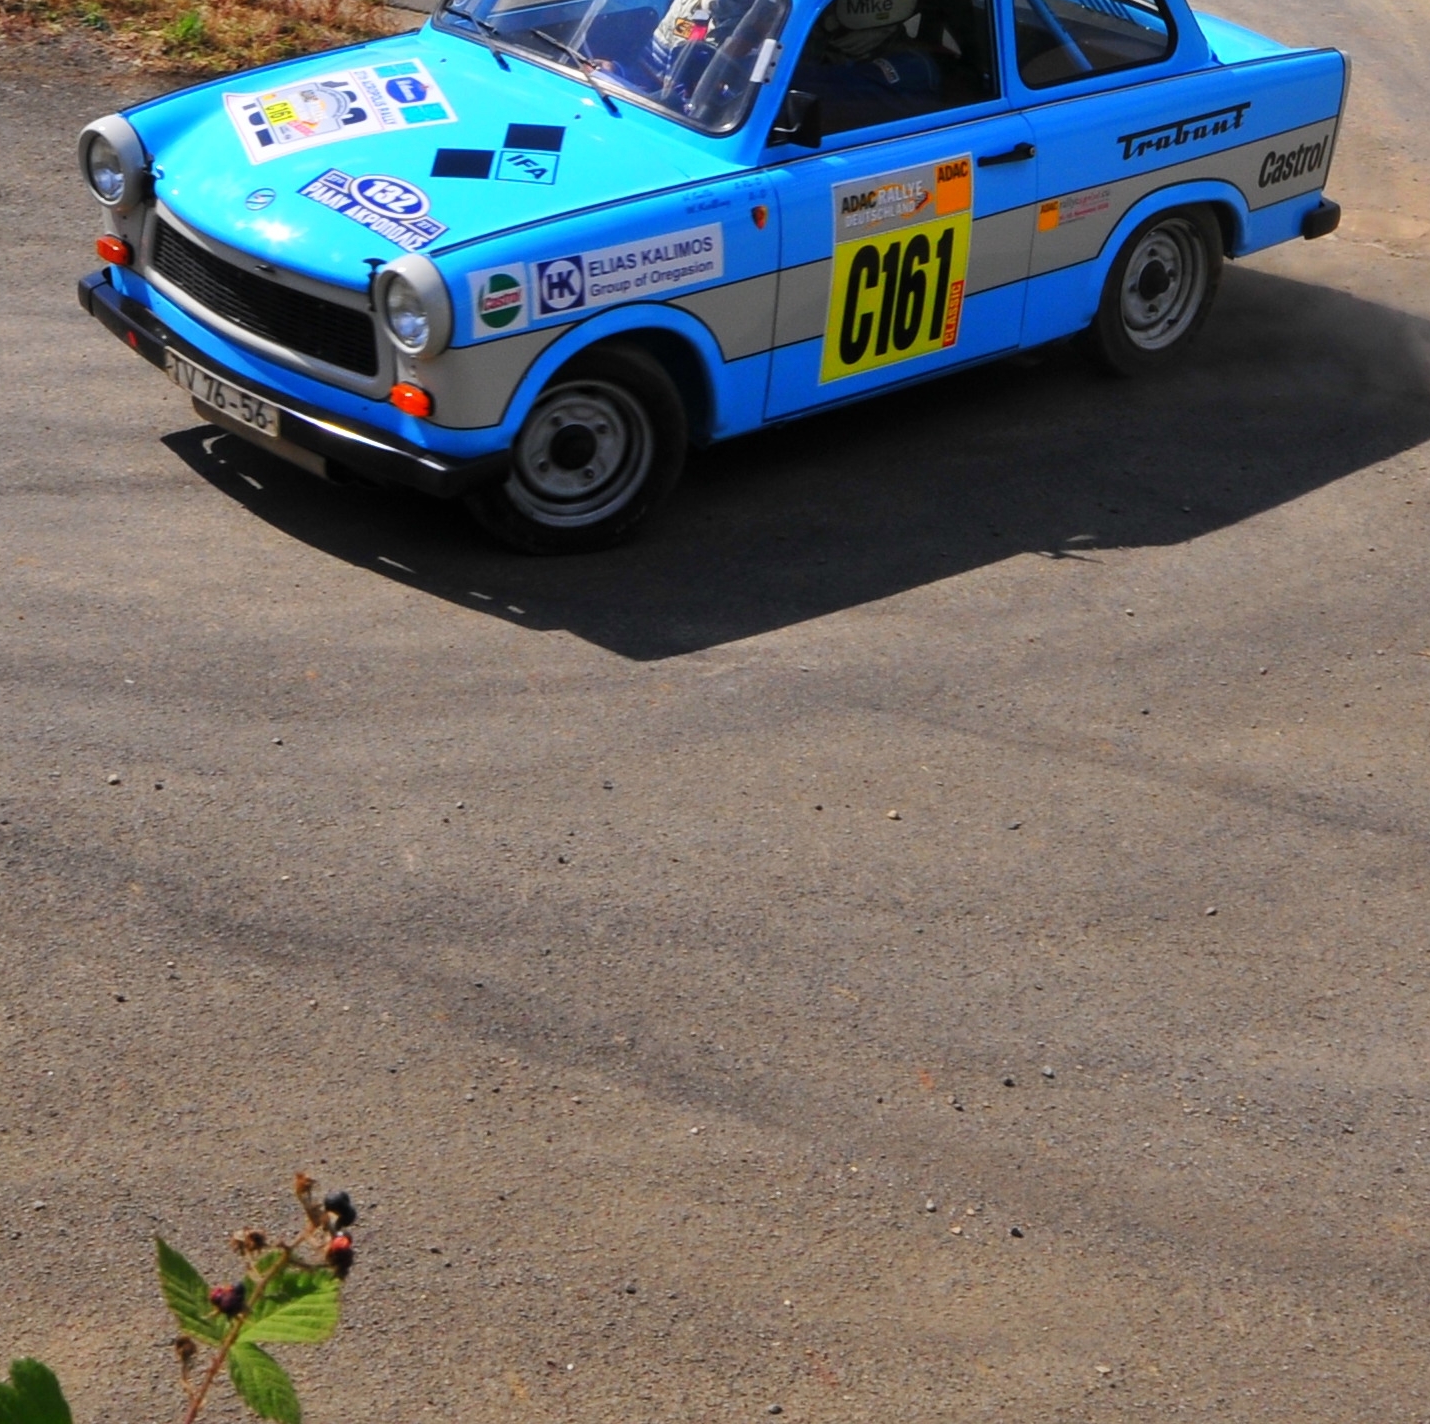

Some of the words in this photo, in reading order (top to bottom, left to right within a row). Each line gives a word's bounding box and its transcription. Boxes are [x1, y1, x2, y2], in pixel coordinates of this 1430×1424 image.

[1117, 101, 1252, 161] Trabant
[506, 154, 548, 180] IFA
[937, 161, 968, 184] ADAC
[1258, 135, 1329, 189] Castrol
[364, 180, 419, 214] 132
[841, 190, 877, 214] ADAC
[877, 180, 923, 206] RALLYE
[845, 200, 916, 228] DEUTSCHLAND
[588, 253, 637, 277] ELIAS
[640, 236, 713, 265] KALIMOS
[546, 270, 577, 301] HK
[590, 278, 630, 297] Group
[633, 270, 649, 288] of
[651, 260, 714, 285] Oregasion
[839, 227, 954, 365] C161
[483, 290, 522, 309] Castrol
[944, 284, 961, 344] CLASSIC
[203, 375, 268, 427] 76-56
